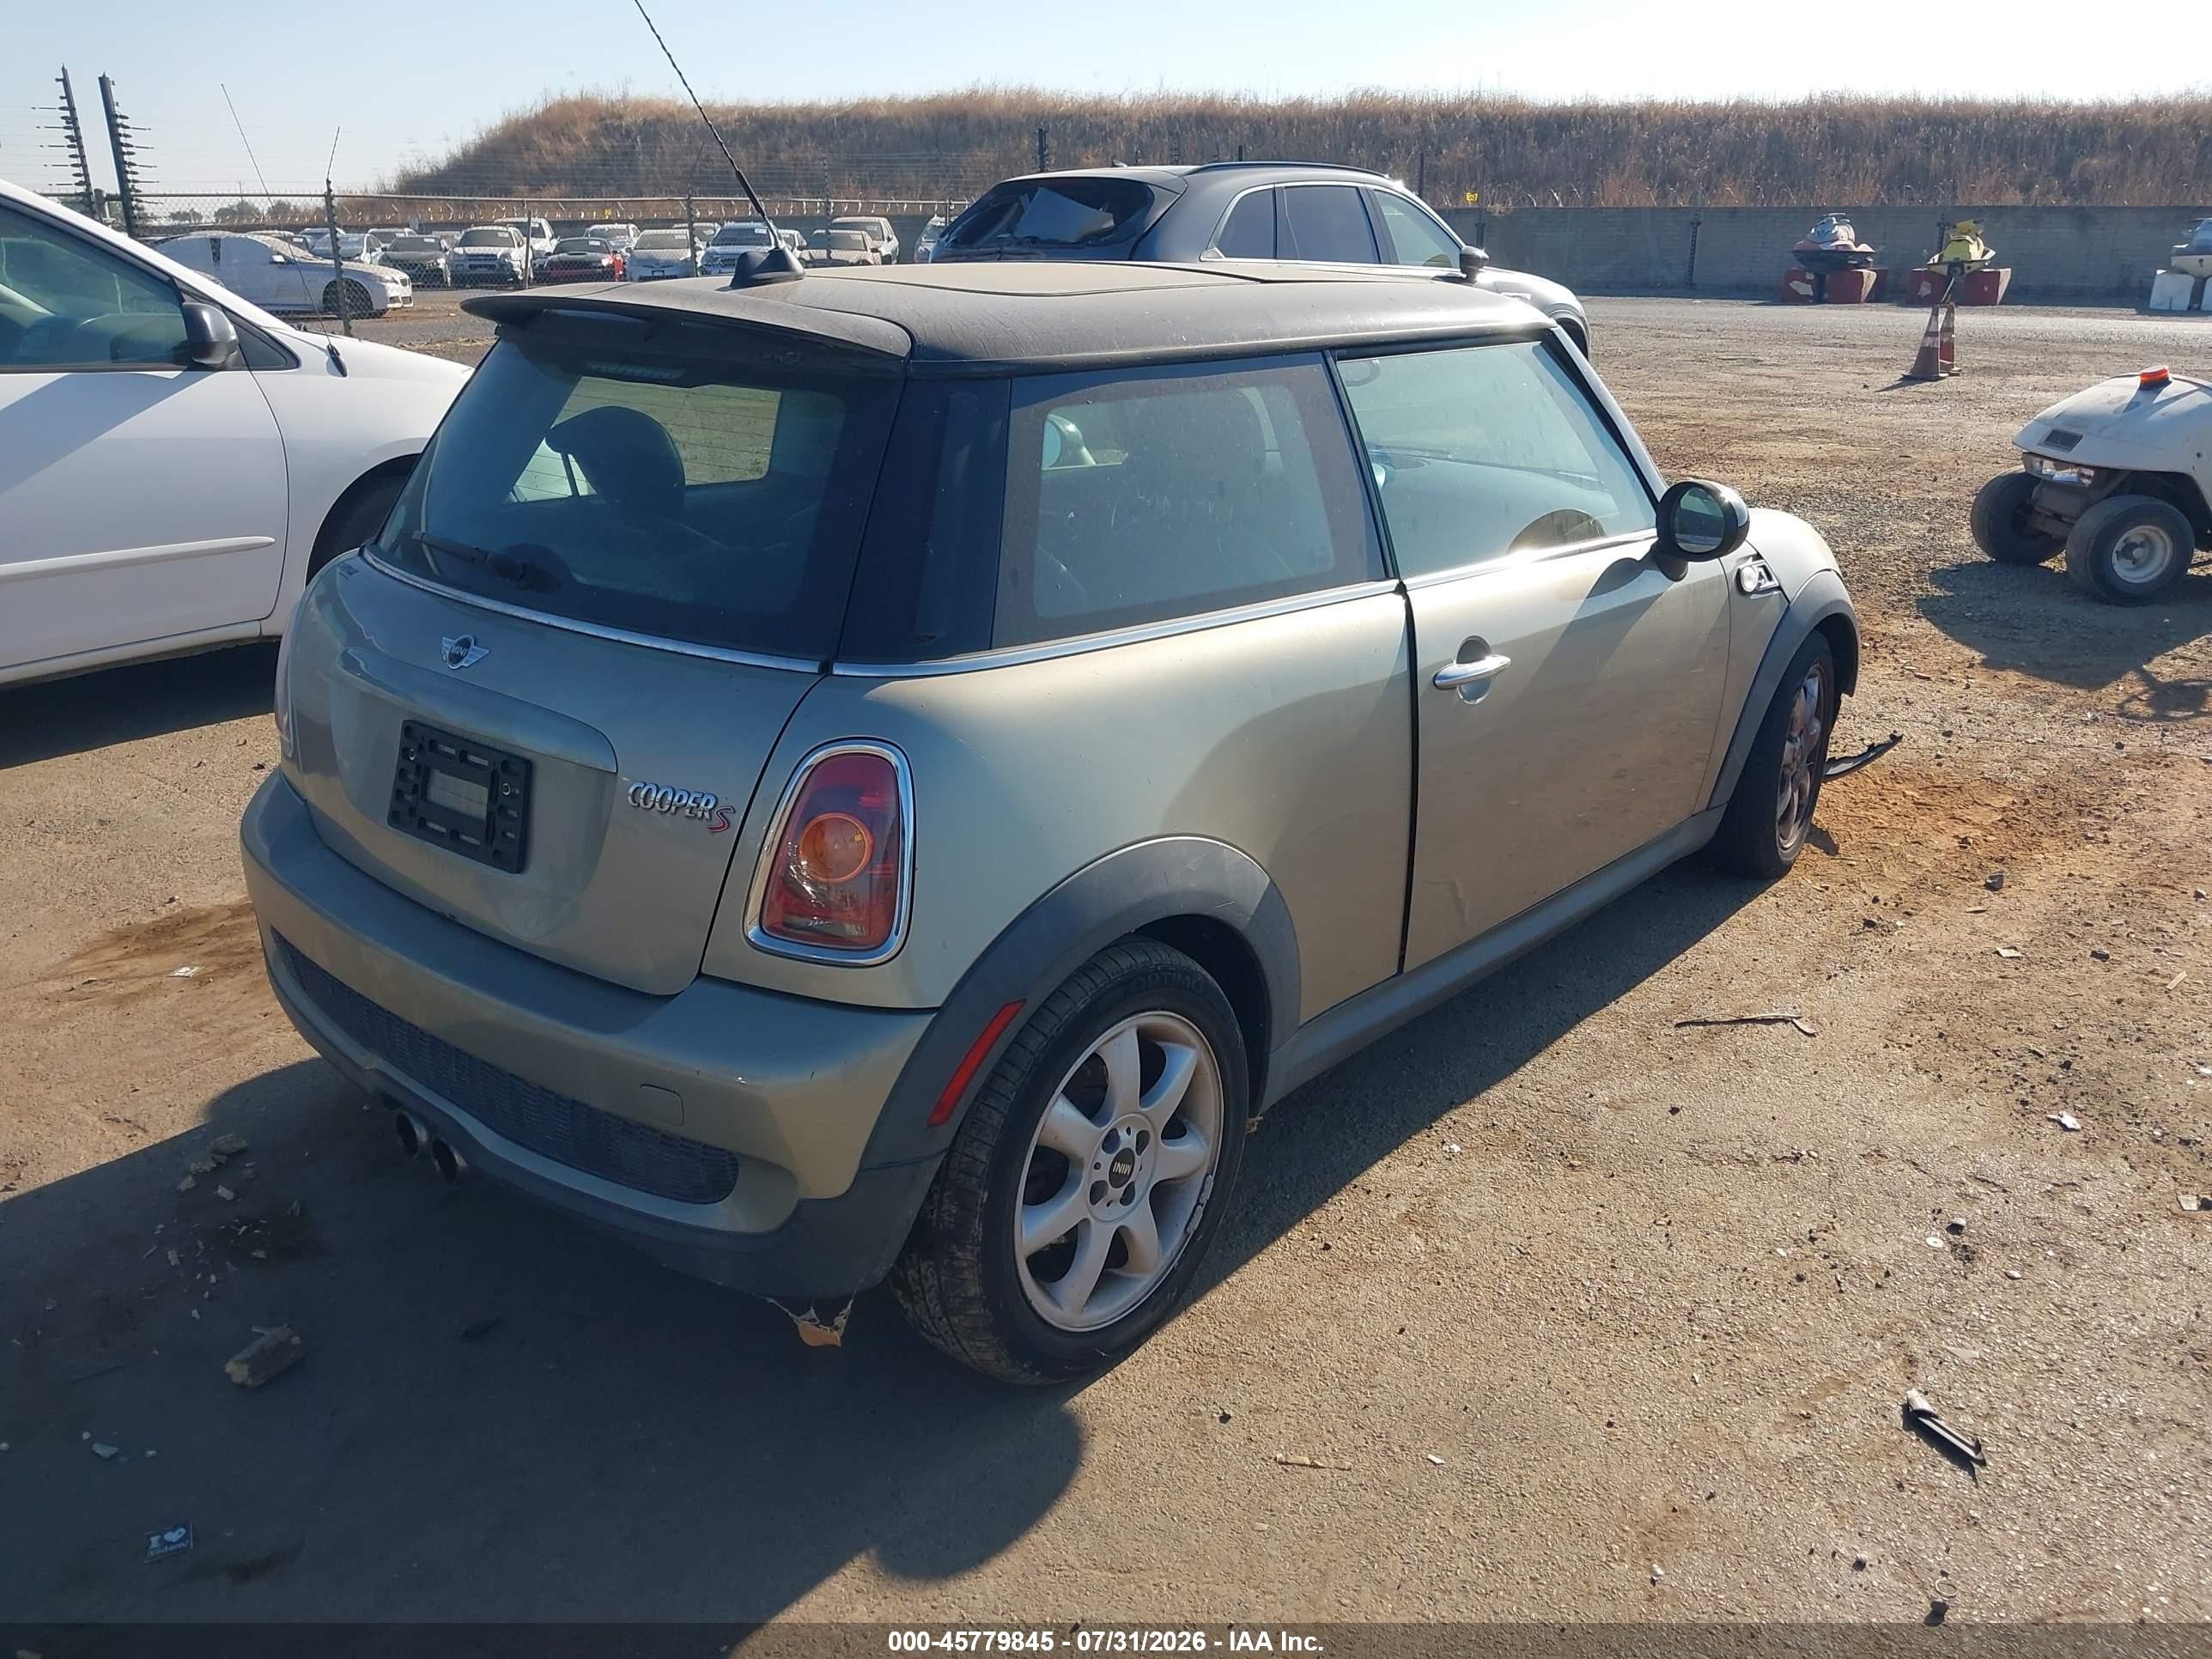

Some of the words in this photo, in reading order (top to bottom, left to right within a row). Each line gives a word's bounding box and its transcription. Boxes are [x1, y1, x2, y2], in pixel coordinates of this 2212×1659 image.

[453, 645, 468, 657] MINI
[628, 781, 717, 822] COOPER
[708, 805, 736, 832] S
[1130, 971, 1204, 994] OPTIMO
[1112, 1161, 1133, 1176] MINI
